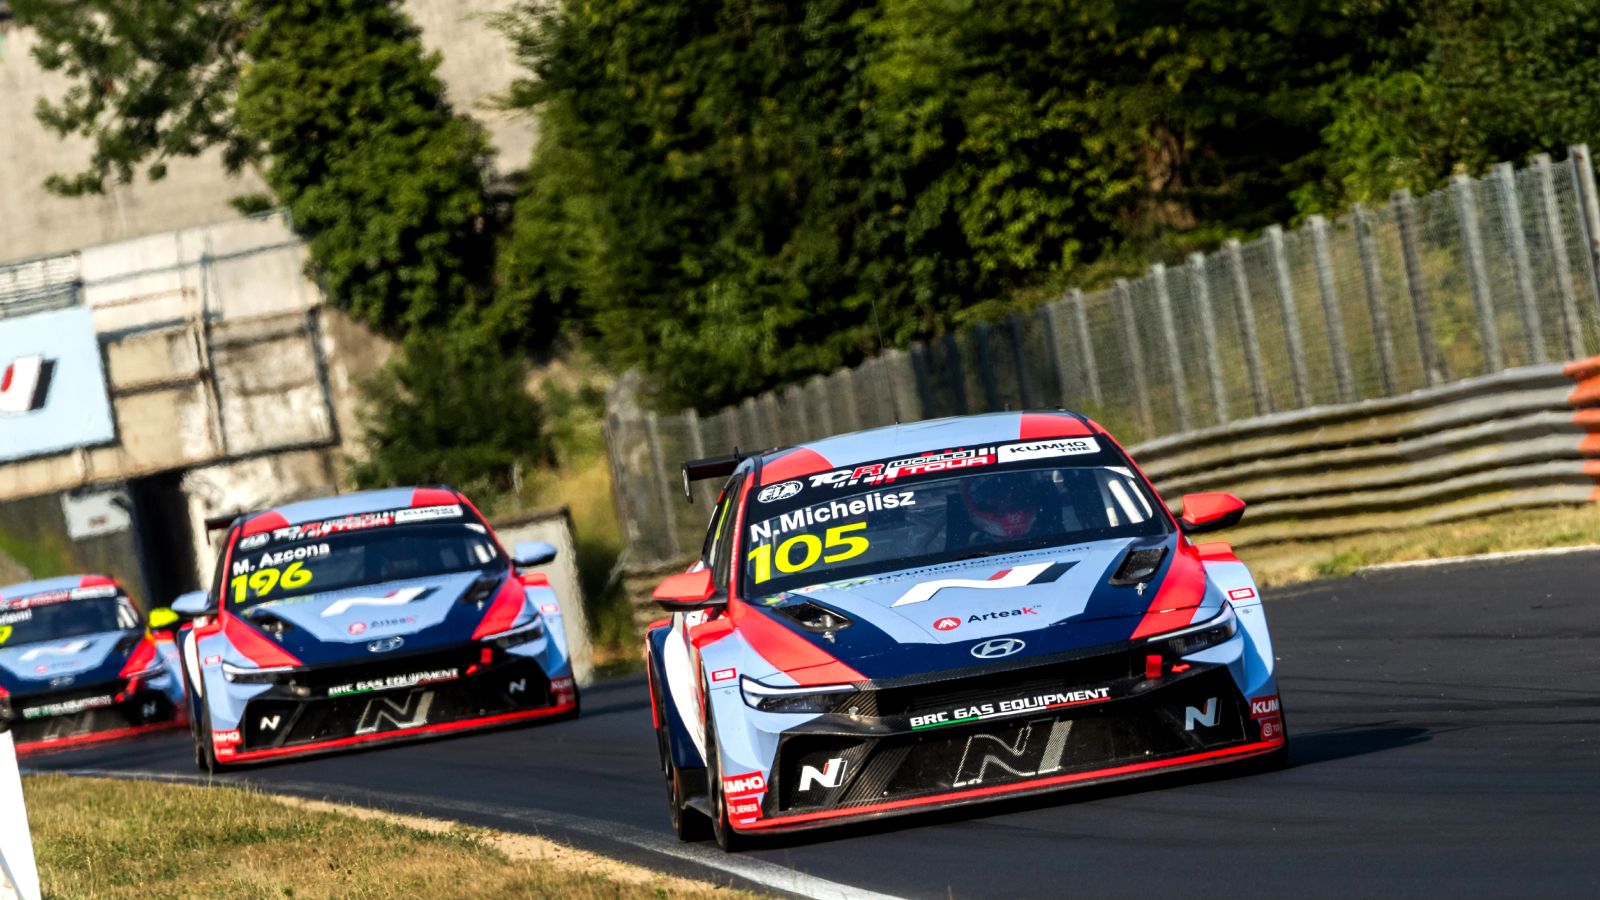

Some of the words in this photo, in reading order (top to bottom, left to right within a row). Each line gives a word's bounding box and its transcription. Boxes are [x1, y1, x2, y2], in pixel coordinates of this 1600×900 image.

[1009, 441, 1087, 453] KUMHO
[808, 464, 885, 487] TCR
[909, 456, 989, 474] TOUR
[760, 483, 797, 501] FIA
[750, 491, 916, 542] N.Michelisz
[233, 559, 255, 575] M.
[260, 543, 330, 567] Azcona
[747, 522, 870, 585] 105
[968, 546, 1091, 566] MOTORSPORT
[231, 561, 313, 604] 196
[328, 683, 354, 695] BRC
[356, 680, 384, 691] GAS
[387, 668, 459, 686] EQUIPMENT
[910, 711, 948, 727] BRC
[954, 704, 994, 720] GAS
[999, 688, 1110, 712] EQUIPMENT
